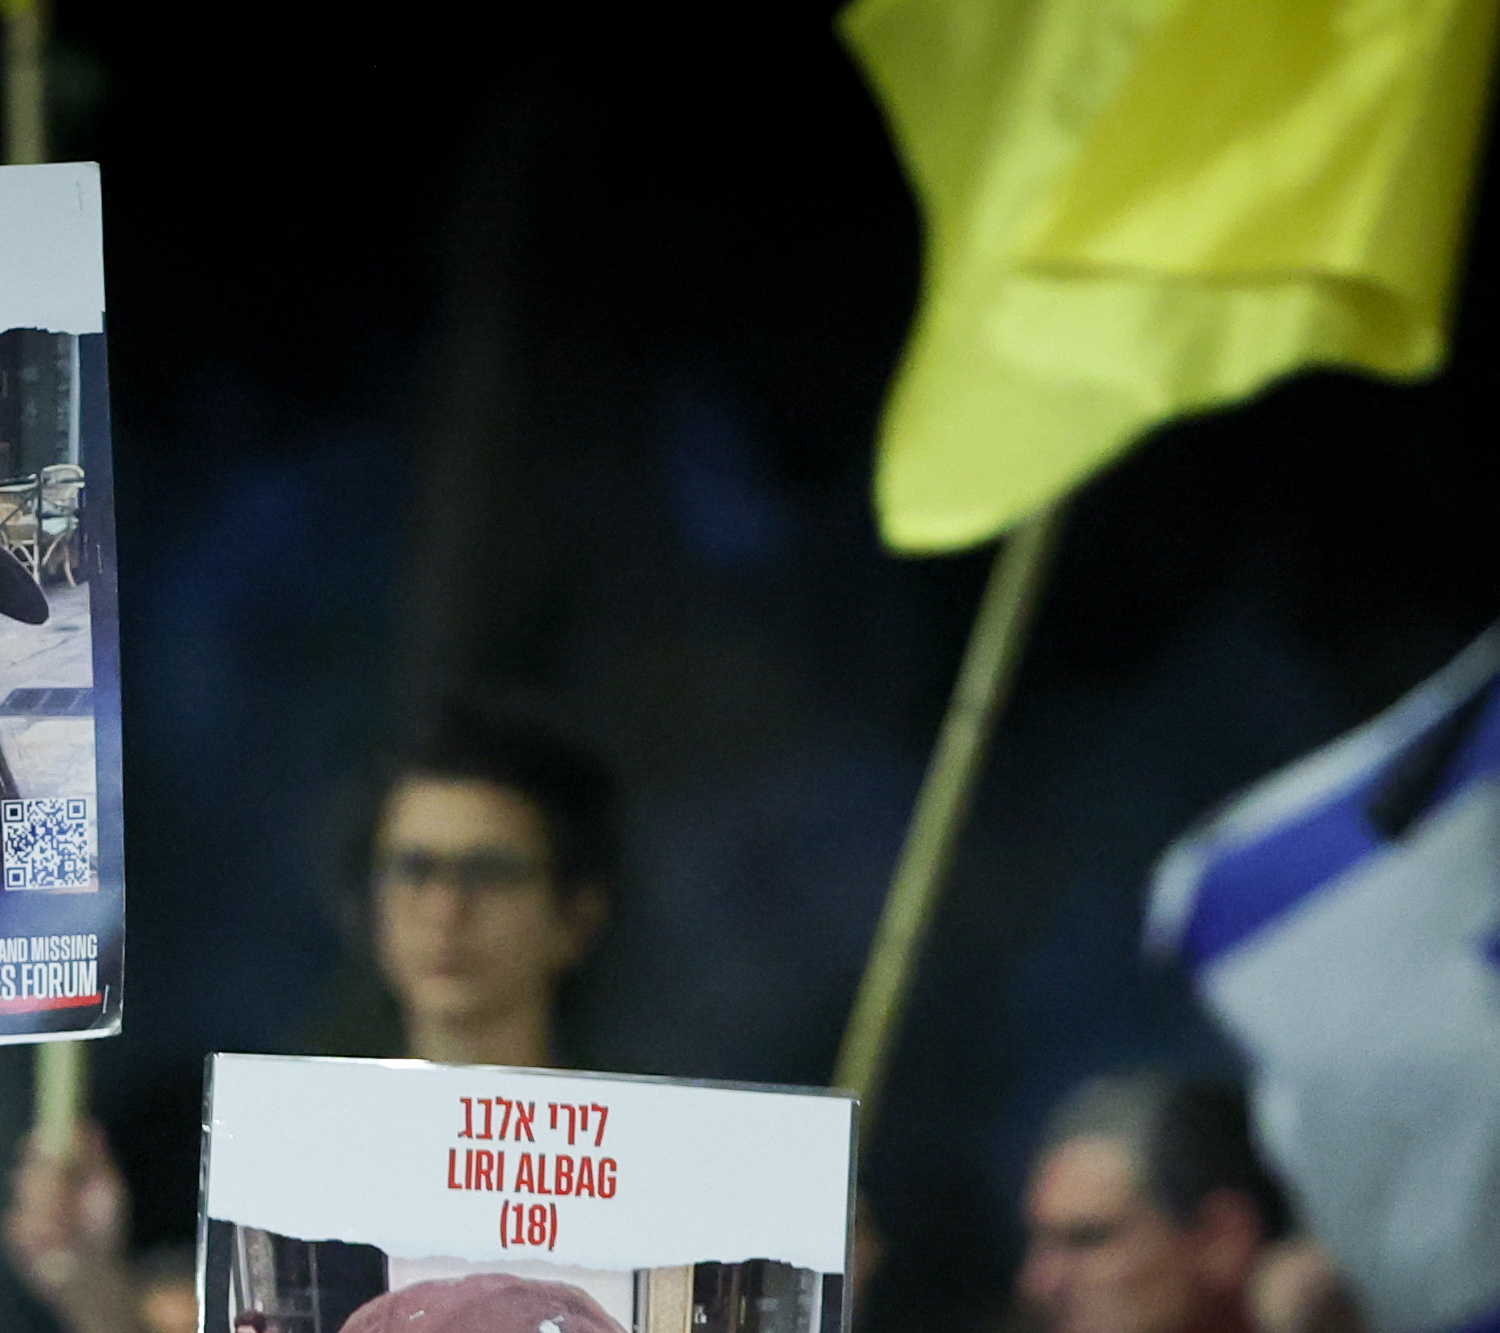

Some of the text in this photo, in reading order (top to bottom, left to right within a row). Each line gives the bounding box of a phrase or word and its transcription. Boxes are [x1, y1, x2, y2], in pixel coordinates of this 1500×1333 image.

[30, 933, 98, 961] MISSING
[22, 961, 98, 1000] FORUM
[457, 1096, 609, 1147] לירי אלבג
[447, 1148, 618, 1200] LIRI ALBAG
[499, 1200, 559, 1252] (18)
